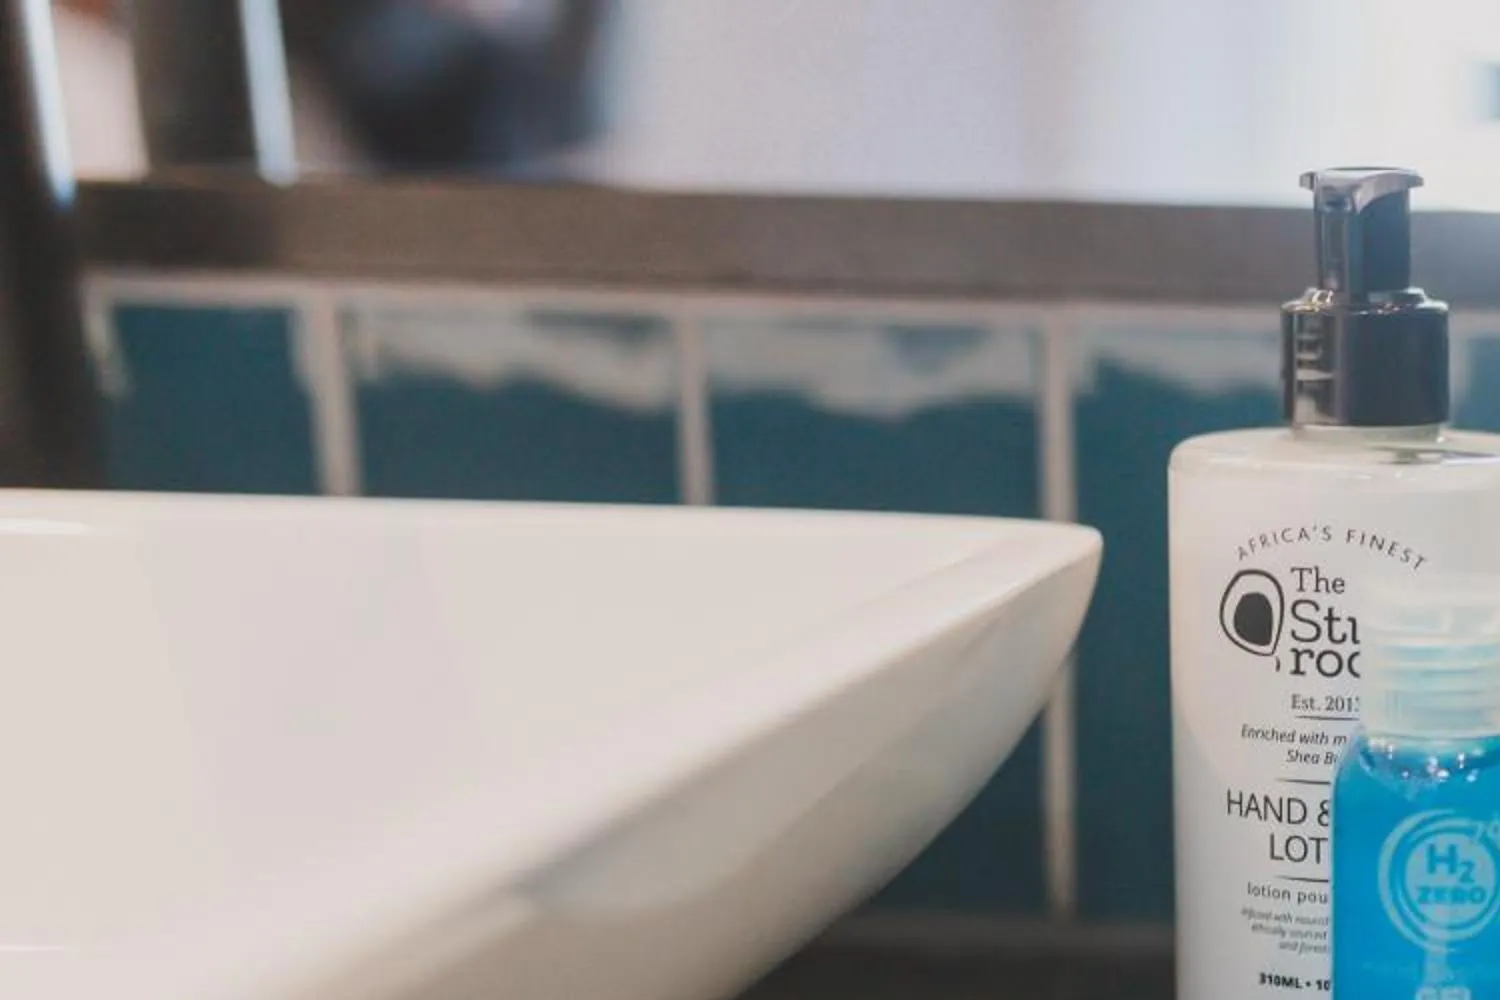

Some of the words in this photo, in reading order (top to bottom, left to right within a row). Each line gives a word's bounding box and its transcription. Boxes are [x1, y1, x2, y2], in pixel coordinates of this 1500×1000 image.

[1236, 525, 1332, 560] AFRICA'S
[1345, 529, 1428, 571] FINEST
[1290, 566, 1345, 594] The
[1290, 599, 1360, 644] Sti
[1290, 693, 1321, 712] Est.
[1240, 723, 1295, 745] Enriched
[1299, 730, 1329, 746] with
[1286, 749, 1320, 765] Shea
[1226, 789, 1307, 826] HAND
[1269, 833, 1329, 865] LOT
[1247, 882, 1291, 901] lotion
[1416, 886, 1487, 905] ZERO
[1257, 971, 1303, 990] 310ML
